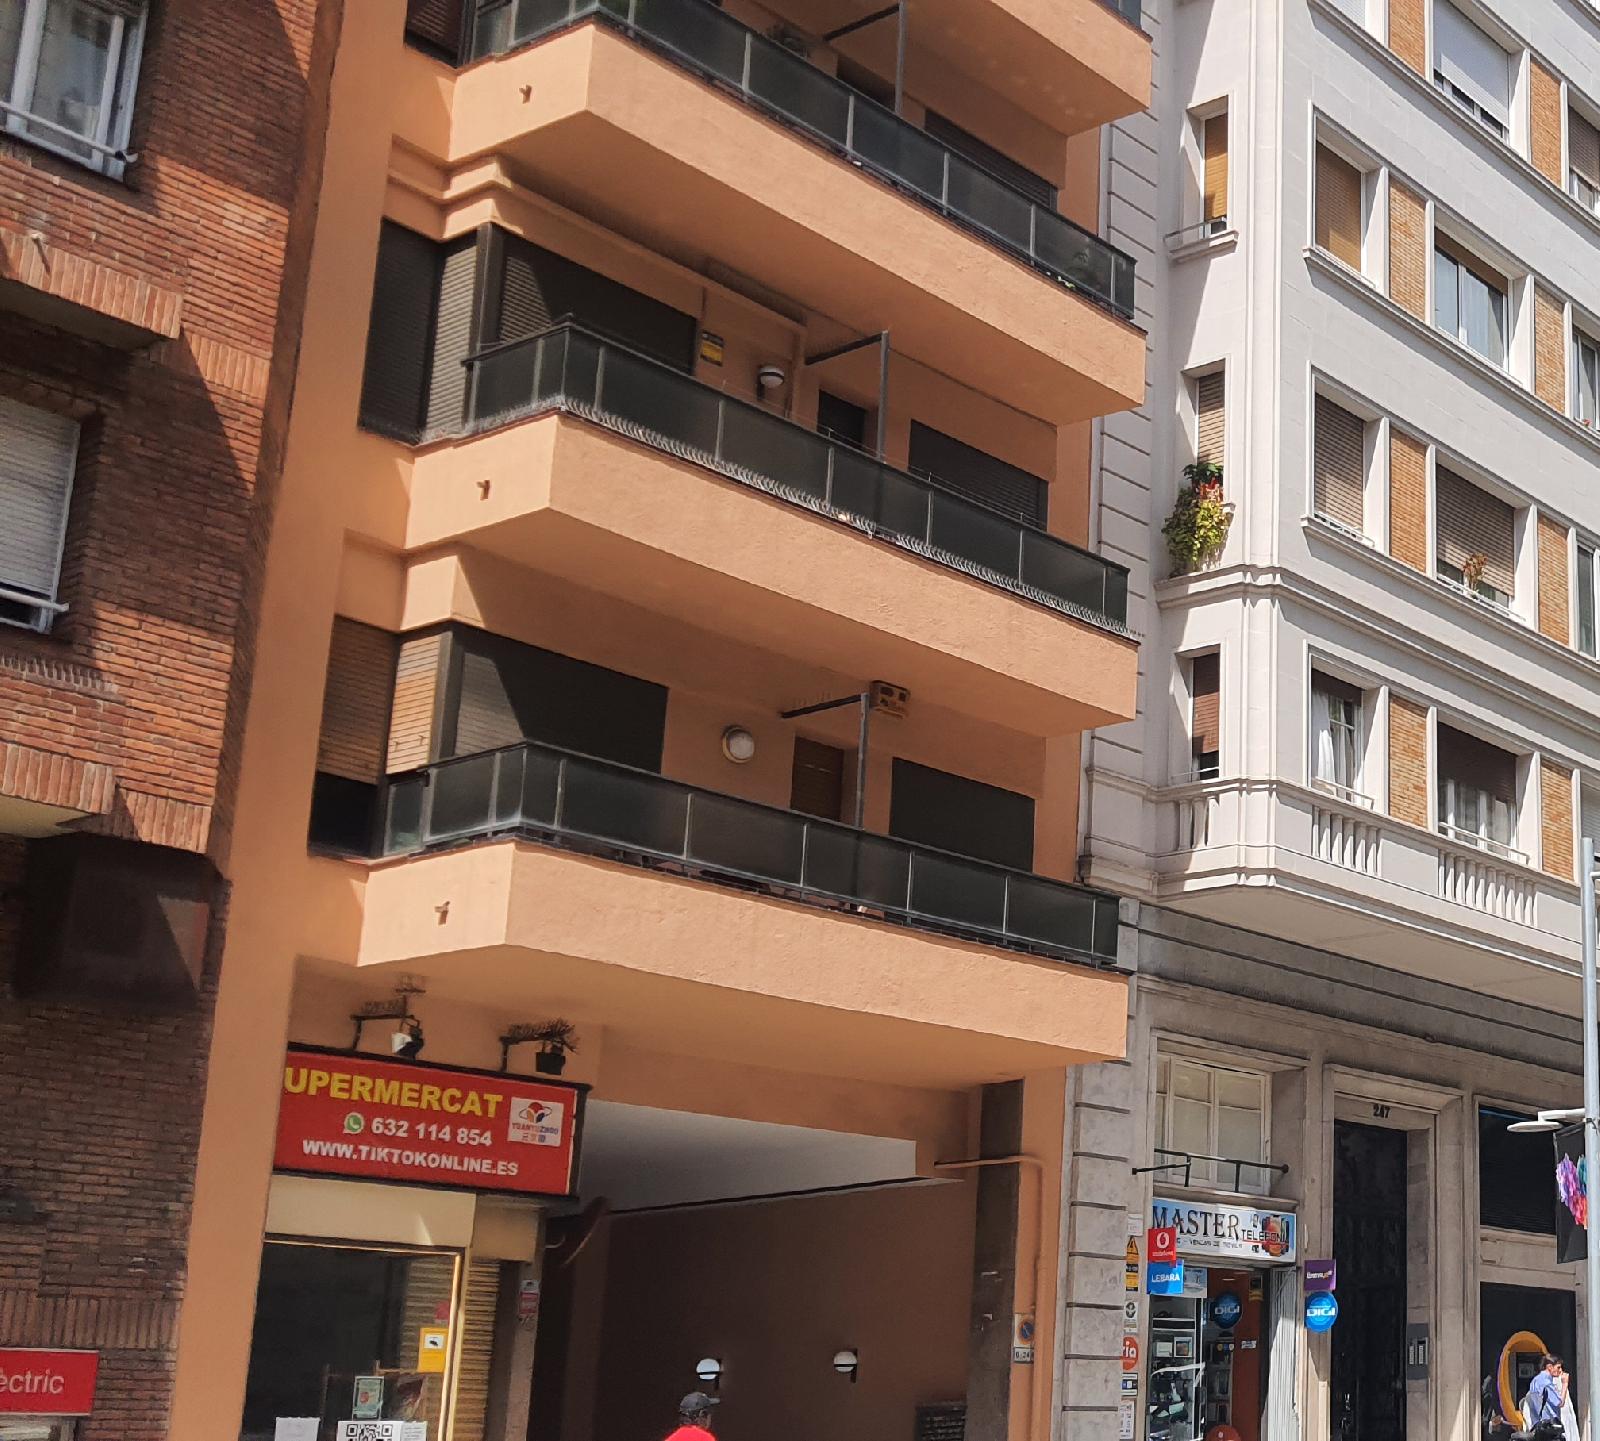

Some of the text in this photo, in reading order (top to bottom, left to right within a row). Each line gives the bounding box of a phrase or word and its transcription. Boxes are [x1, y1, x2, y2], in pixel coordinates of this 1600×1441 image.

[284, 1067, 503, 1118] UPERMERCAT
[1373, 1103, 1390, 1118] 247
[371, 1118, 493, 1147] 632 114 854
[302, 1138, 519, 1177] WWW.TIKTOKONLINE.ES
[1152, 1205, 1240, 1241] MASTER
[1151, 1274, 1181, 1283] LEBARA
[1214, 1305, 1240, 1315] DIGI
[1306, 1307, 1336, 1317] DIGI
